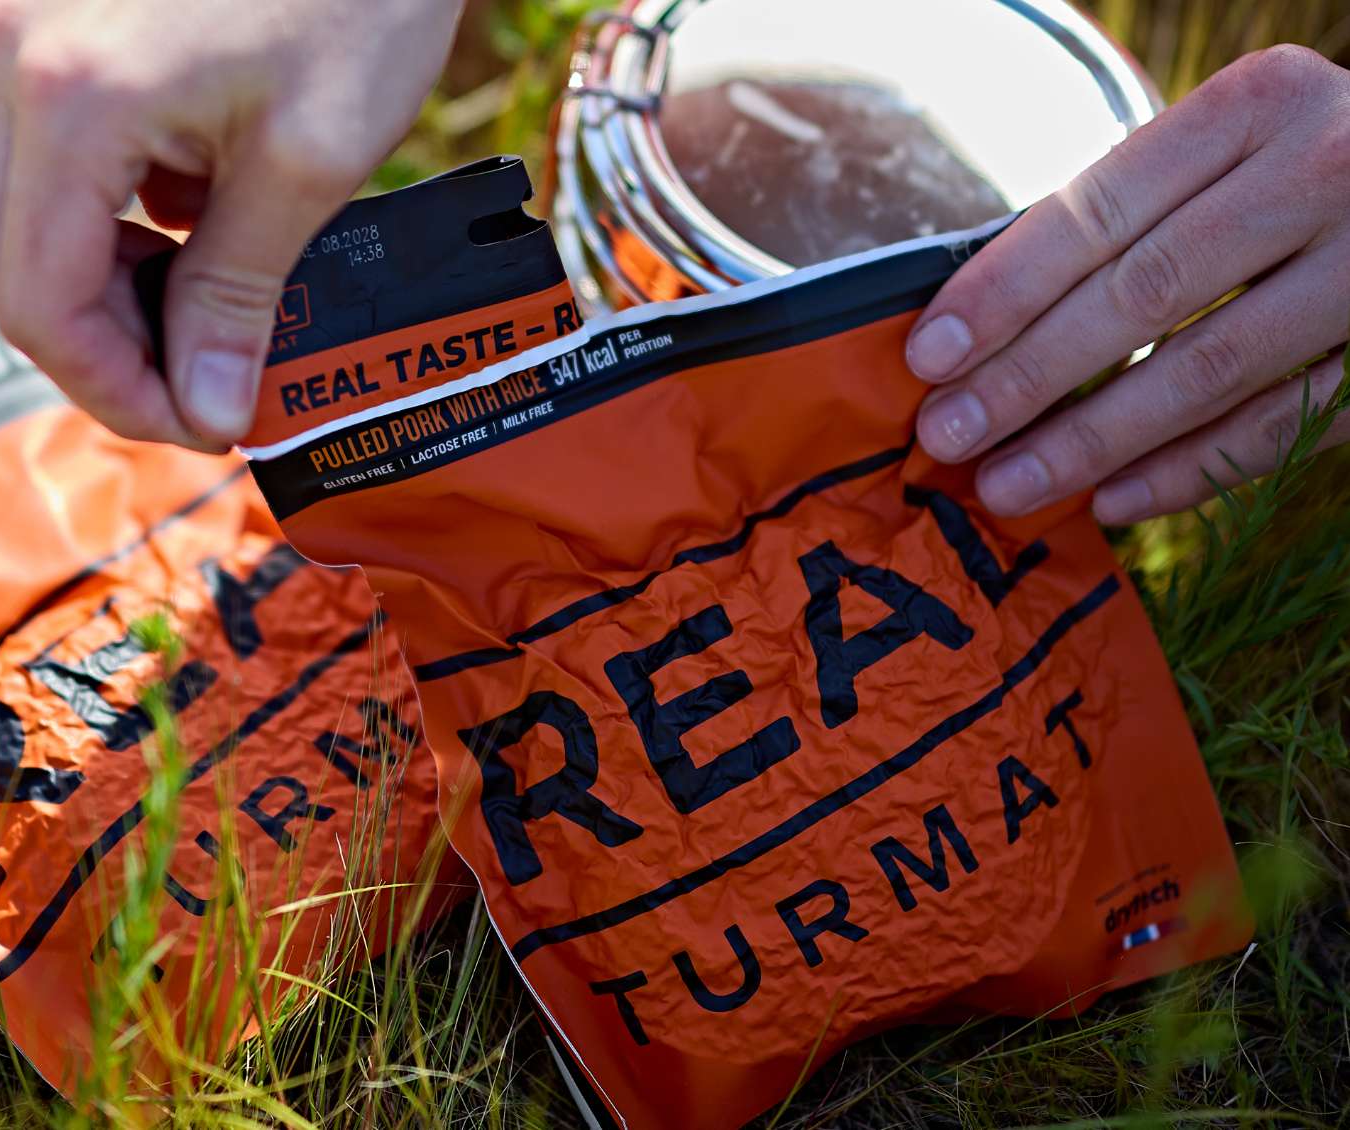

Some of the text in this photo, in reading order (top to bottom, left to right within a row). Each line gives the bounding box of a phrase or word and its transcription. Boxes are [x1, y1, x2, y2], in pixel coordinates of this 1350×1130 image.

[321, 225, 380, 254] 08.2028
[348, 243, 385, 267] 14:38
[279, 361, 381, 417] REAL
[385, 320, 518, 384] TASTE
[618, 329, 643, 345] PER
[624, 333, 674, 359] PORTION
[308, 337, 619, 473] PULLED PORK WITH RICE 547 kcal
[323, 400, 555, 491] GLUTEN FREE LACTOSE FREE MILK FREE
[455, 483, 1049, 888] REAL
[589, 689, 1096, 1048] TURMAT
